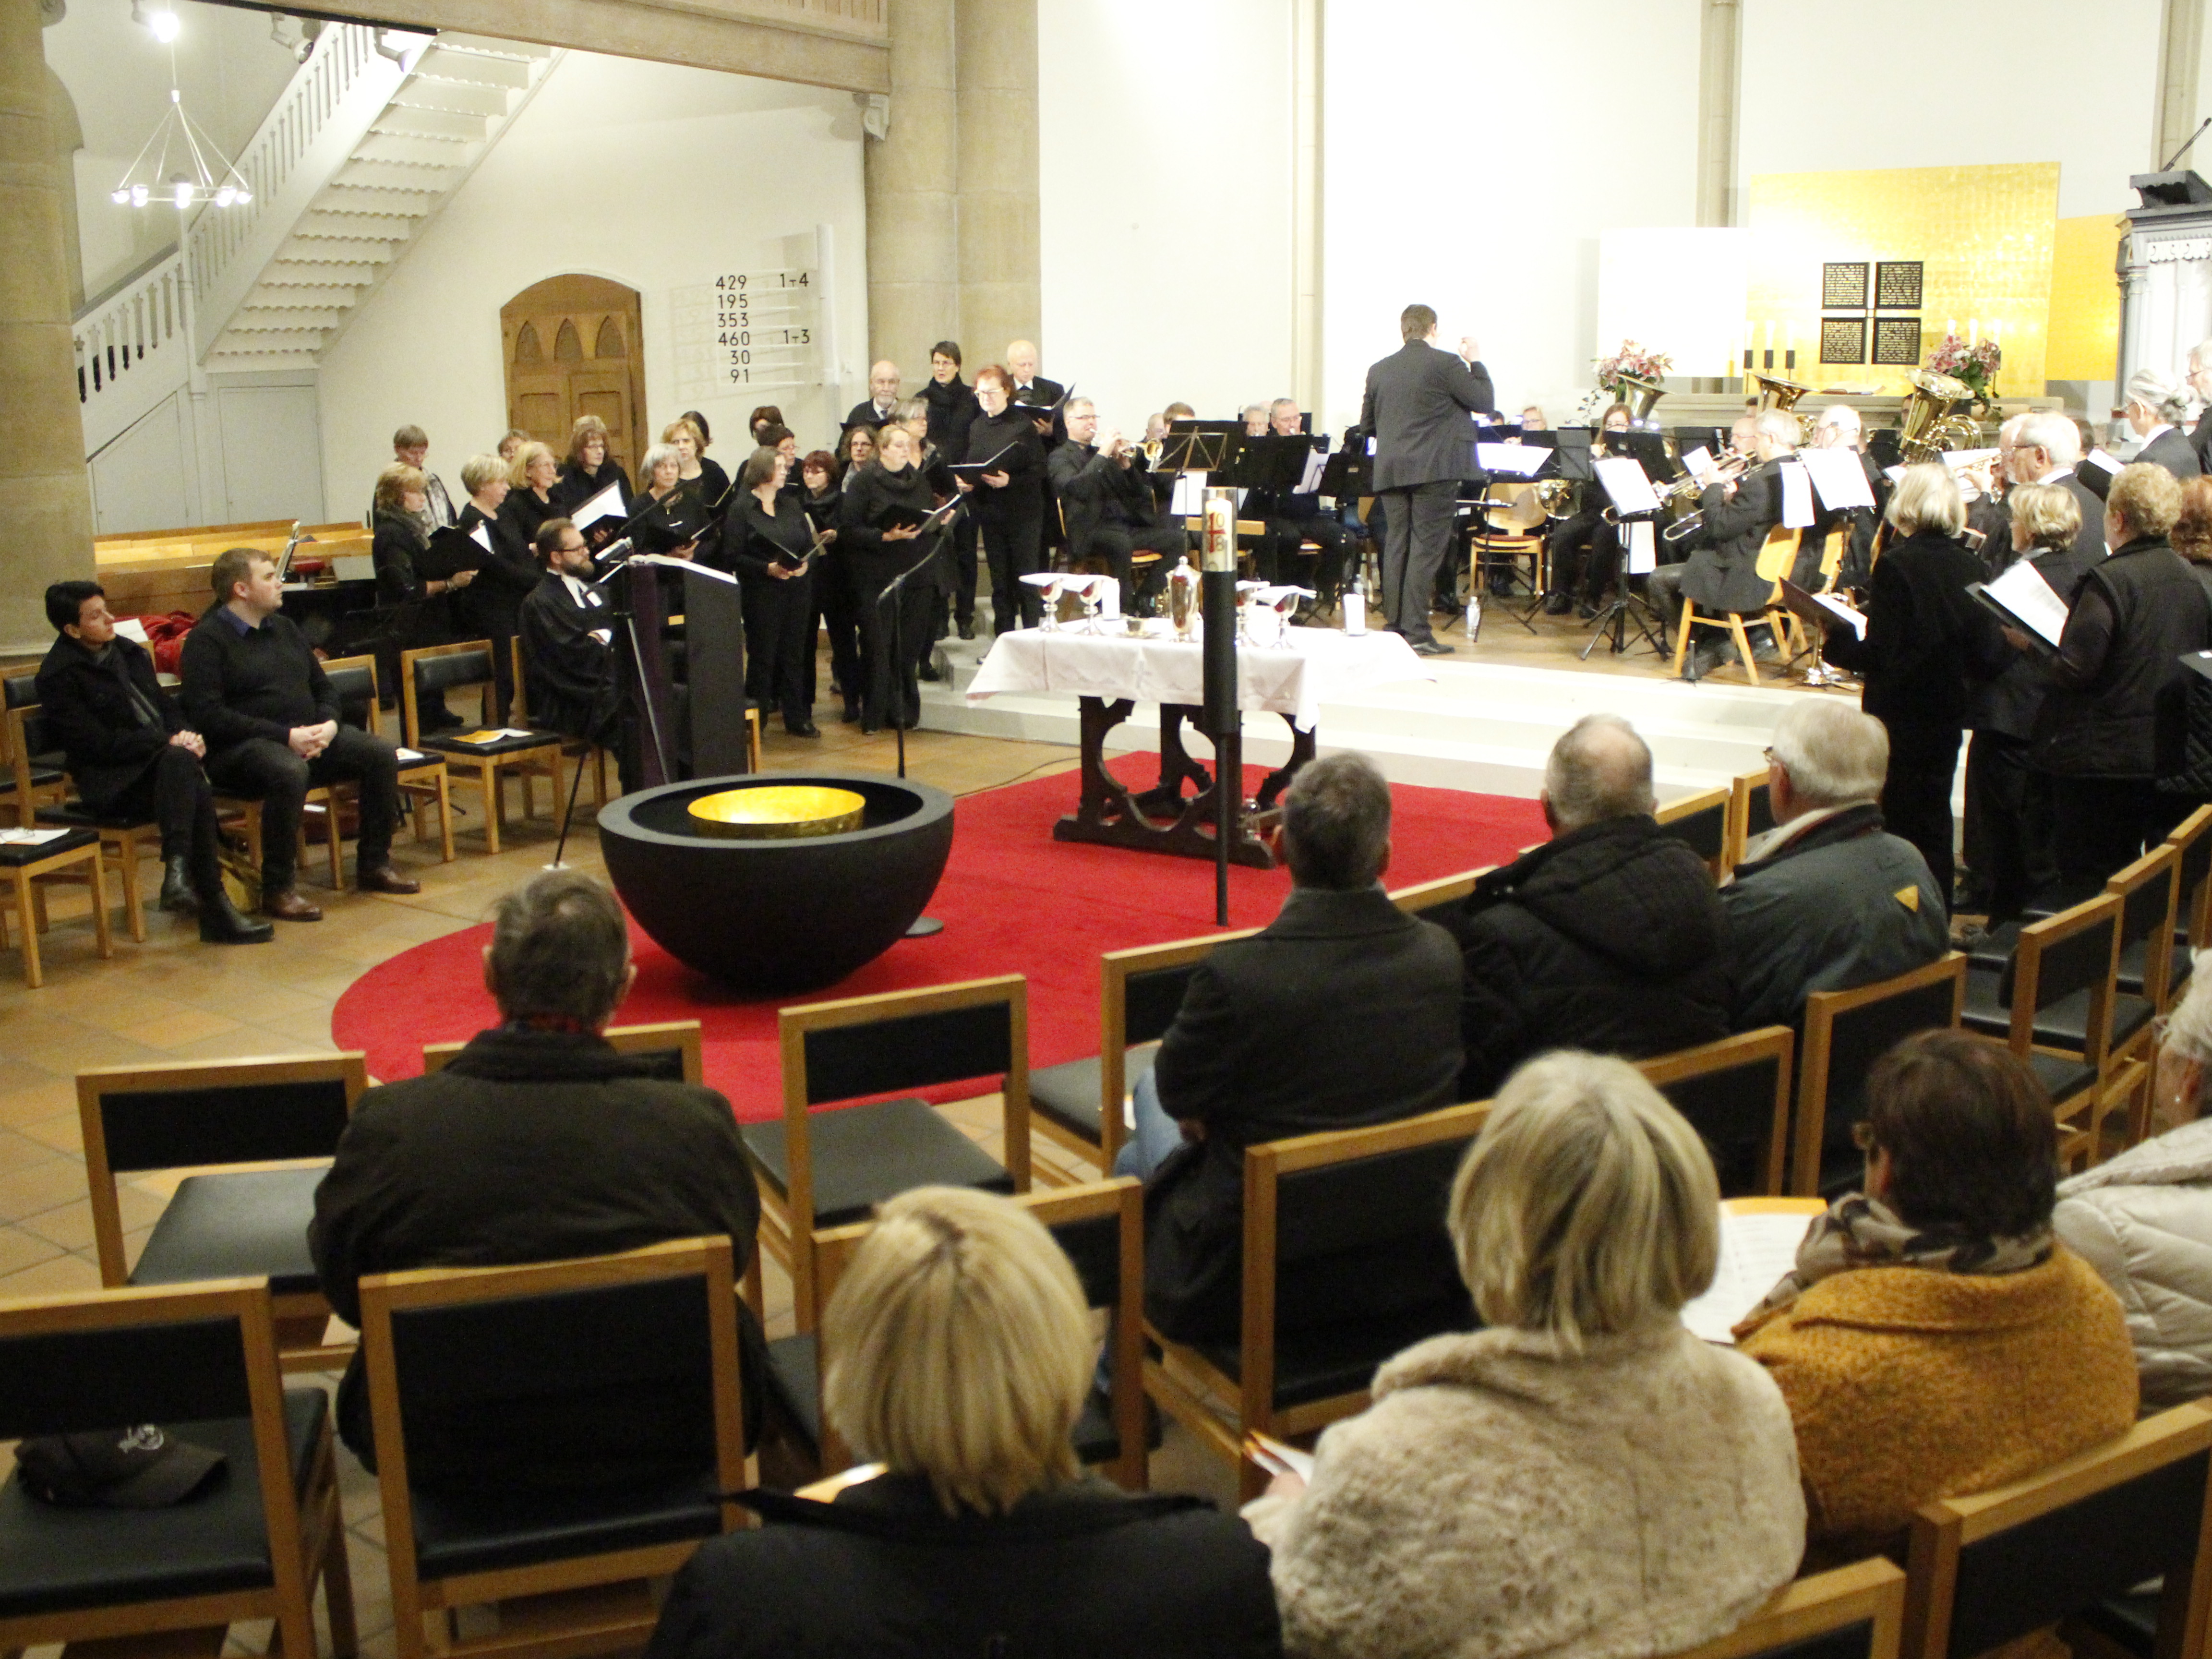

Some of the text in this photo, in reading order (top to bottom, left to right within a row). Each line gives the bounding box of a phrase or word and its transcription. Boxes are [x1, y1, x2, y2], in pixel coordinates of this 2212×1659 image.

[716, 275, 746, 290] 429
[718, 293, 748, 309] 195
[718, 312, 748, 327] 353
[718, 331, 750, 346] 460
[731, 350, 750, 365] 30
[731, 369, 748, 383] 91
